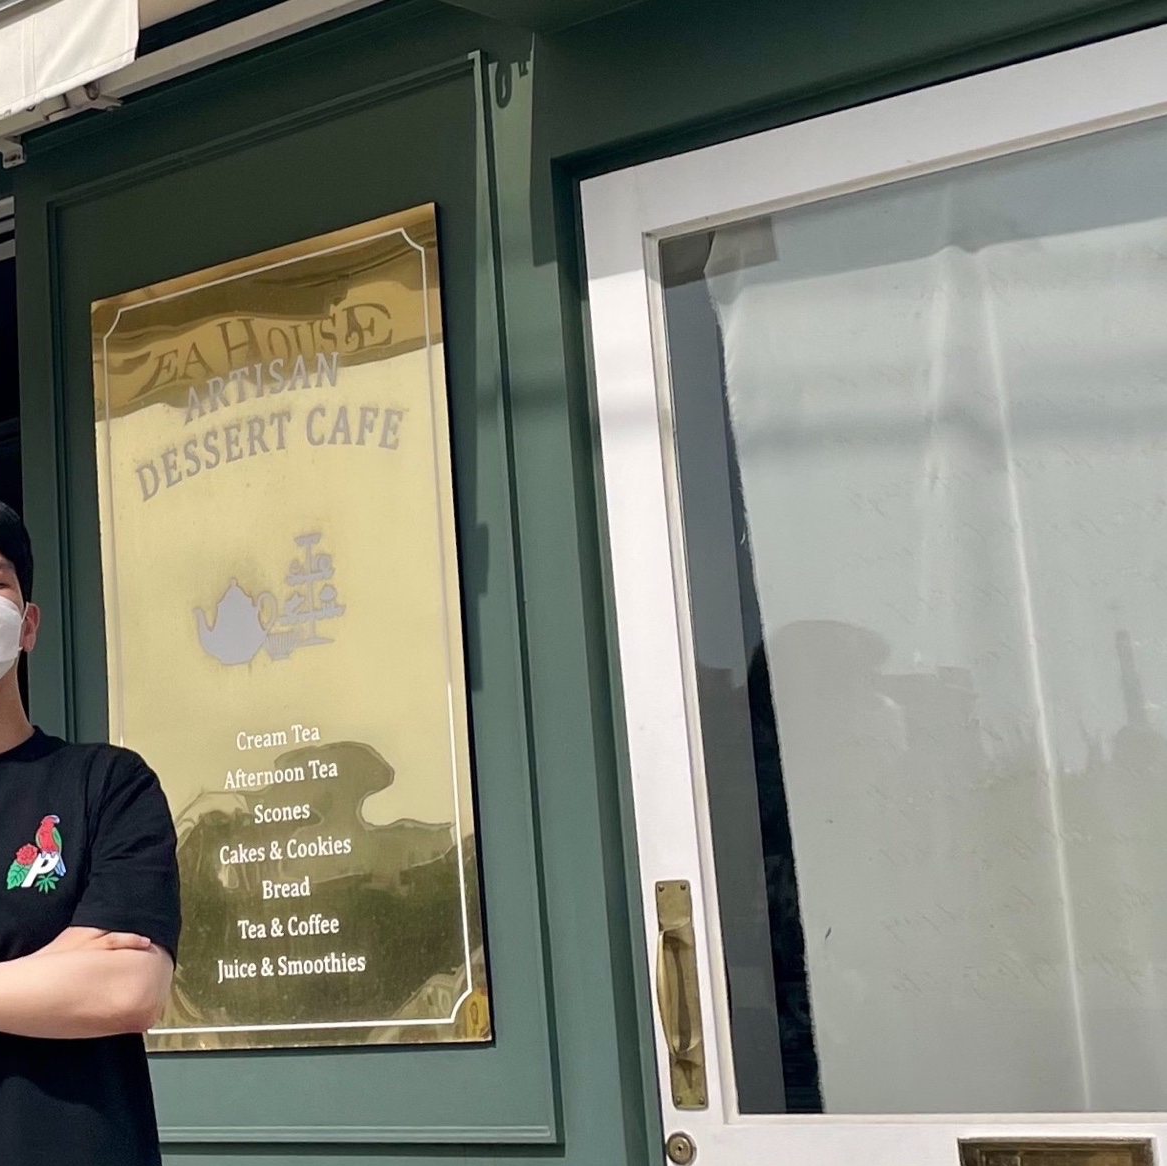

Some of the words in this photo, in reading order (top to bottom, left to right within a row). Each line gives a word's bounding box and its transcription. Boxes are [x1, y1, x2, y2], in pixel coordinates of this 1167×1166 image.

[184, 351, 341, 426] ARTISAN
[135, 409, 293, 503] DESSERT
[305, 405, 406, 451] CAFE
[236, 730, 288, 751] Cream
[291, 724, 321, 743] Tea
[223, 765, 306, 790] Afternoon
[308, 760, 339, 779] Tea
[254, 803, 311, 824] Scones
[219, 843, 266, 865] Cakes
[269, 841, 284, 861] &
[286, 836, 352, 858] Cookies
[21, 851, 60, 888] P
[262, 876, 311, 900] Bread
[237, 919, 268, 939] Tea
[270, 917, 284, 937] &
[287, 914, 340, 936] Coffee
[217, 958, 257, 984] Juice
[260, 957, 275, 977] &
[277, 952, 367, 976] Smoothies
